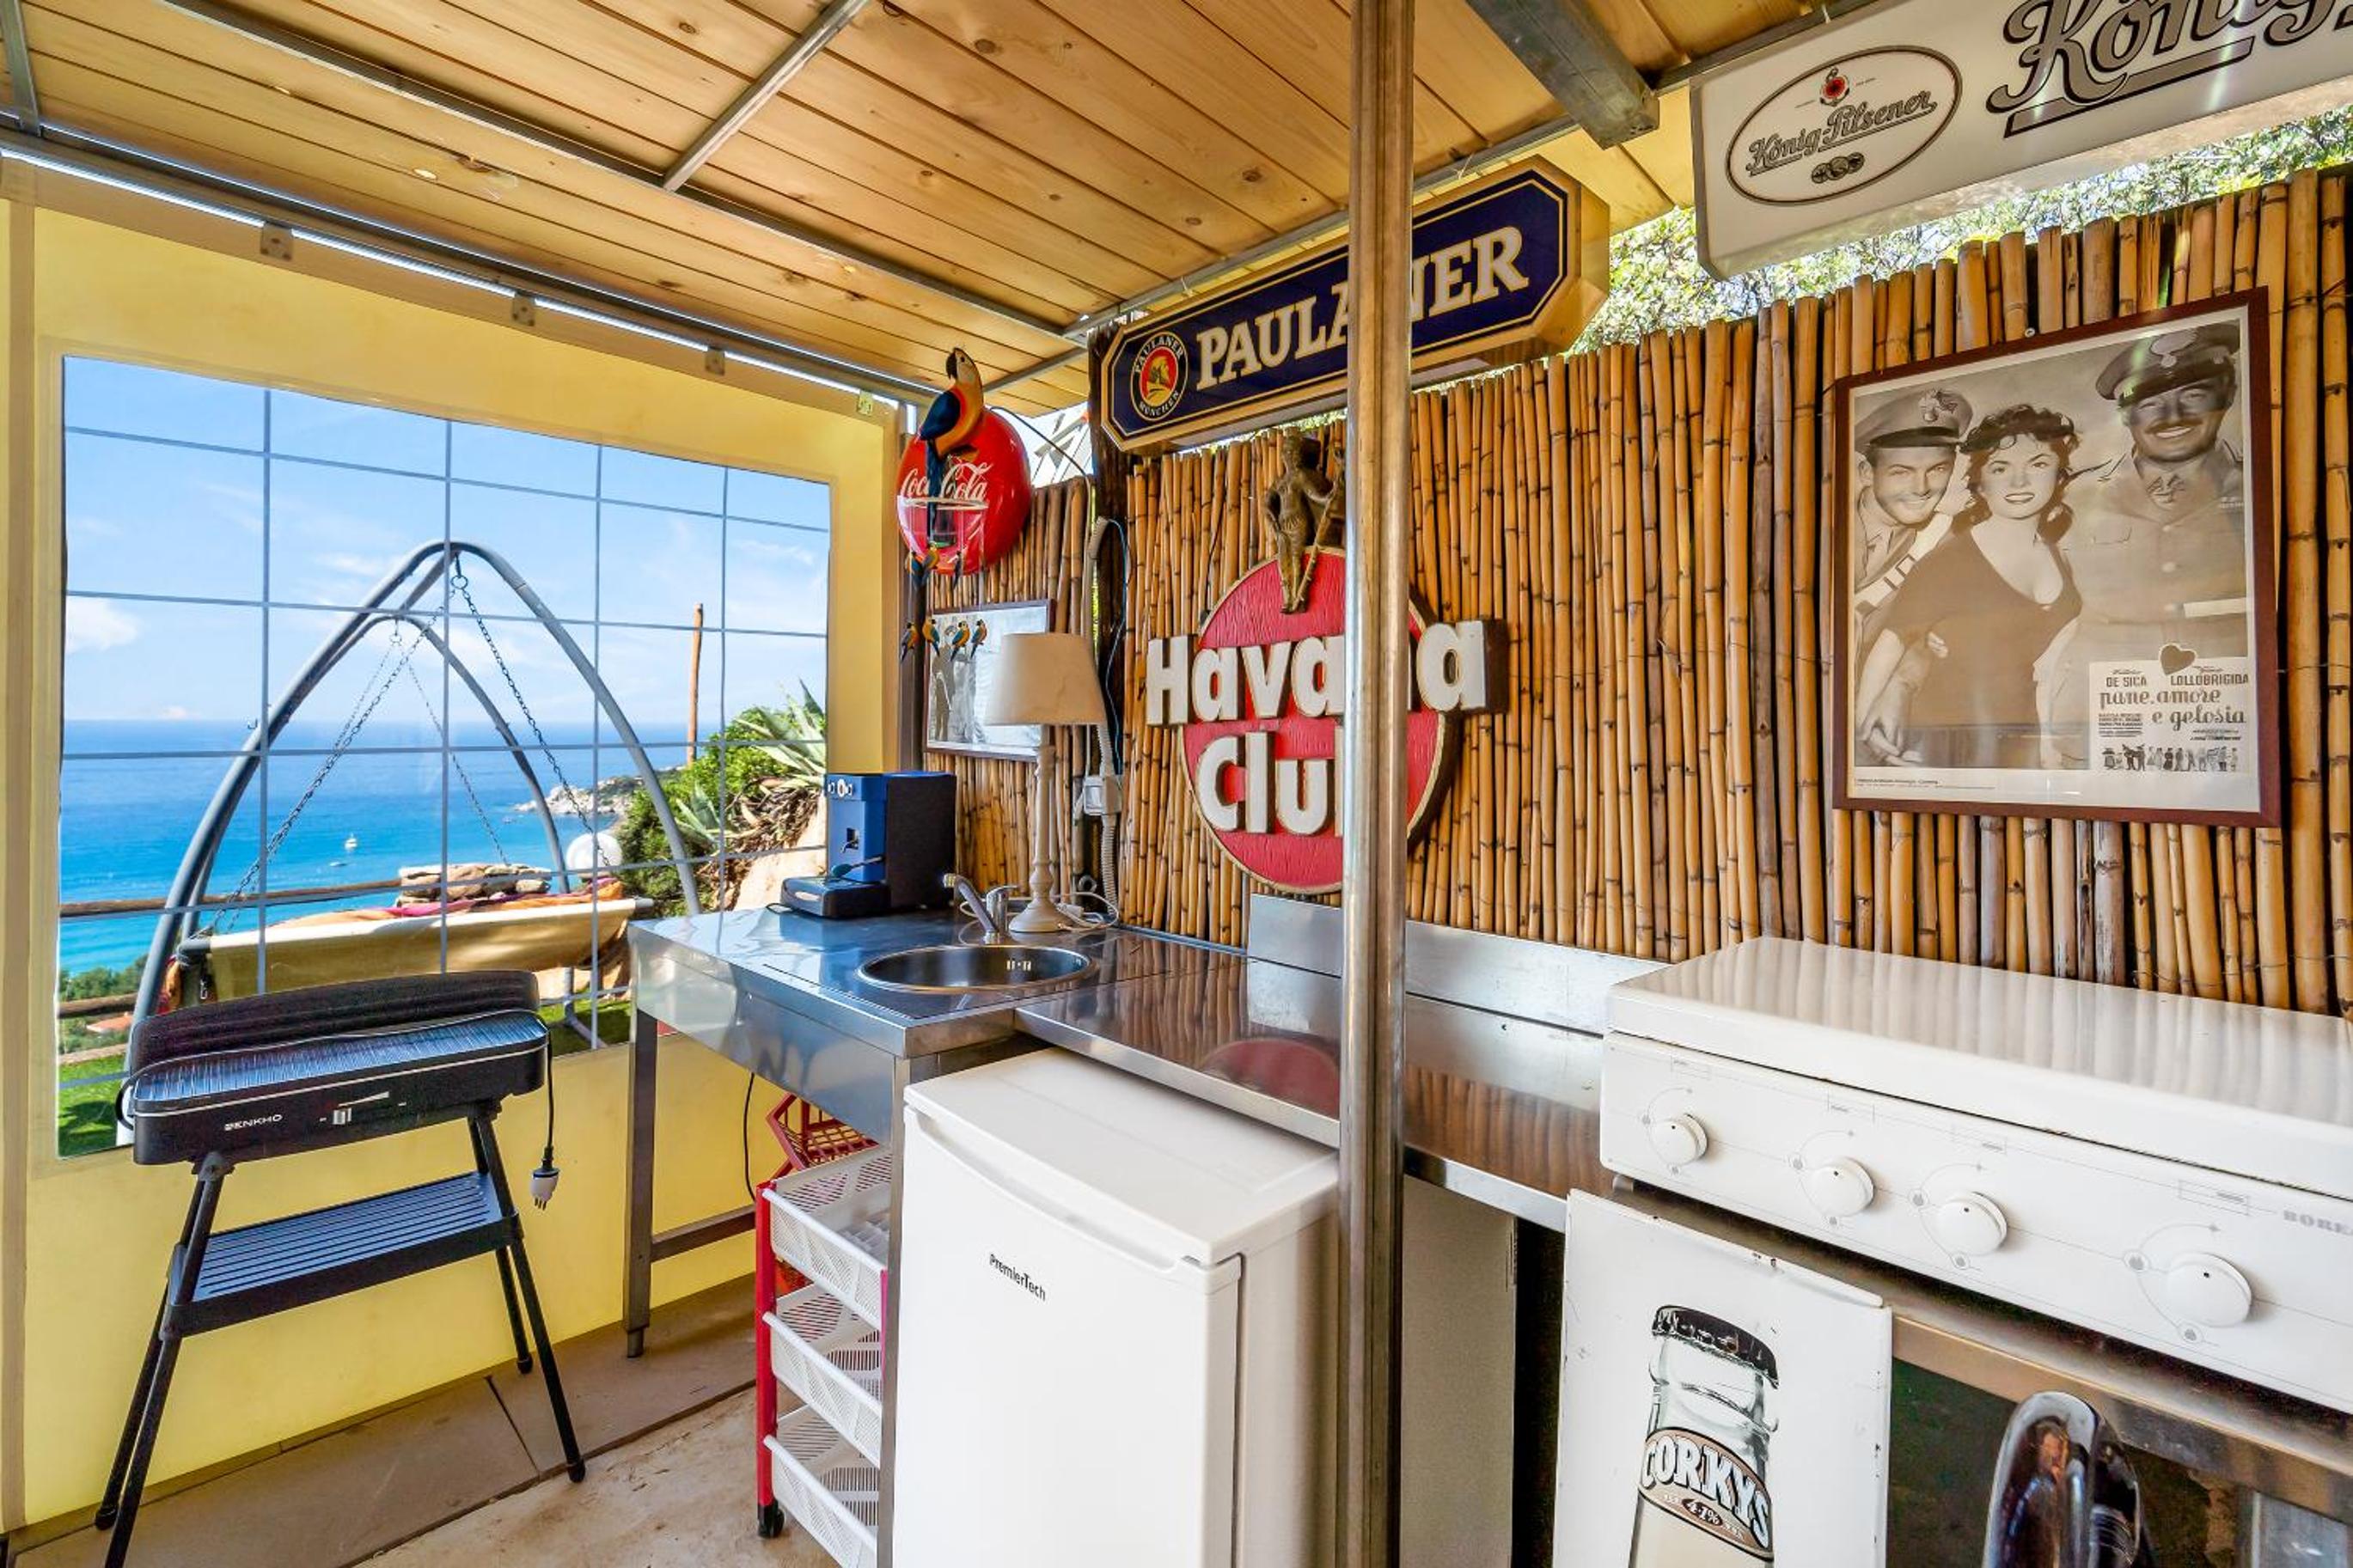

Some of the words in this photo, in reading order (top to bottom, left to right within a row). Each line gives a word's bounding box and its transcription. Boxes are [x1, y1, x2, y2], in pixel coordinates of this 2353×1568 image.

[1745, 89, 1938, 171] König-Pilsener
[1146, 619, 1485, 727] Havaa
[2105, 676, 2120, 687] DE
[2124, 675, 2148, 687] SICA
[2170, 673, 2249, 686] LOLLOBRIGIDA
[2151, 711, 2163, 723] e
[2170, 705, 2246, 731] gelosia
[1198, 728, 1344, 836] Clu
[989, 1254, 1045, 1302] PremierTech
